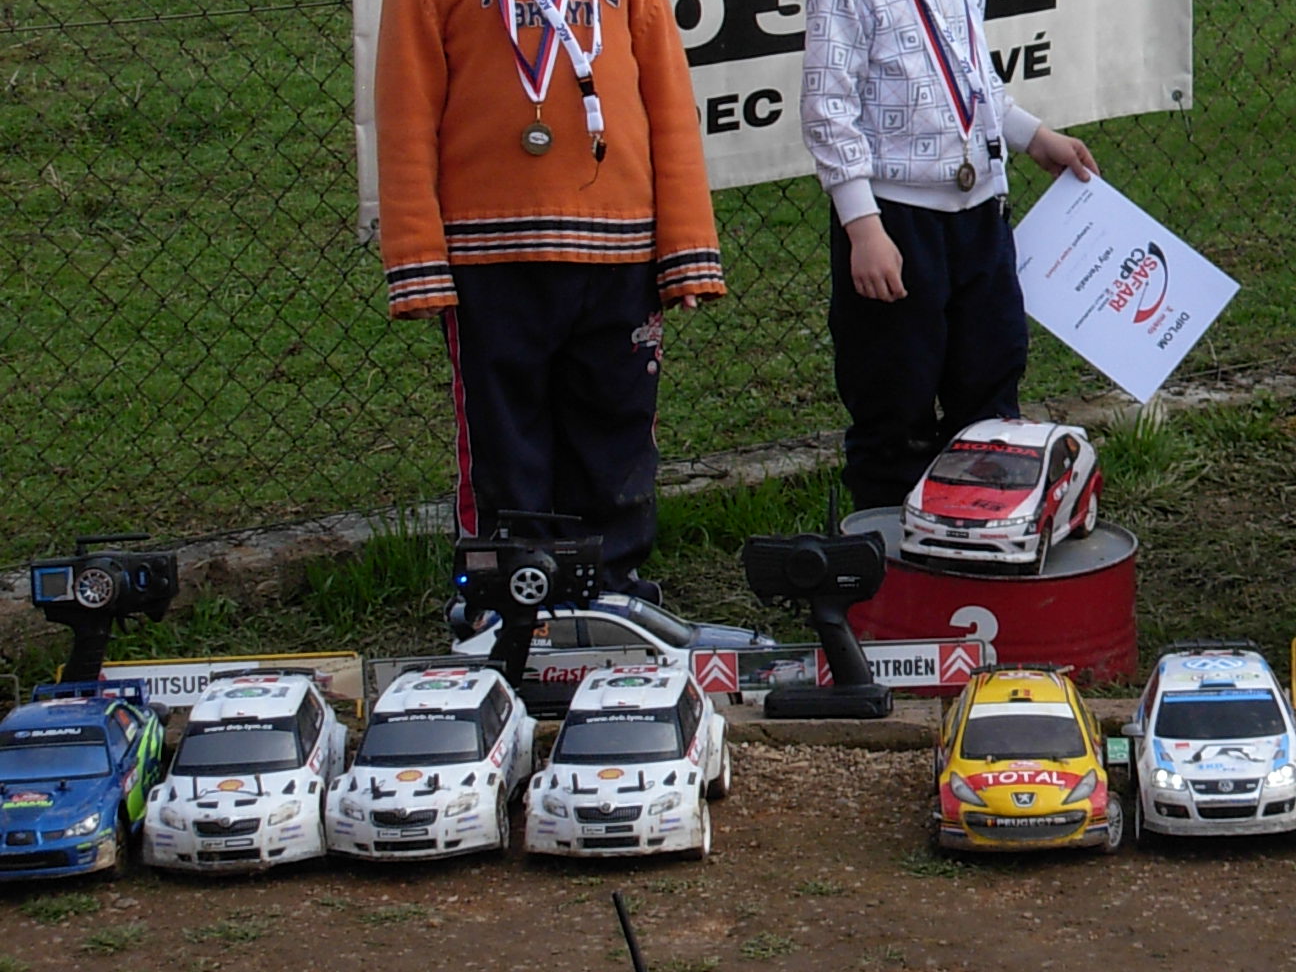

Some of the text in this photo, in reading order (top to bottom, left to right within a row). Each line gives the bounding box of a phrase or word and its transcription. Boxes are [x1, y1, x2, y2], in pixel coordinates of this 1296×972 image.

[556, 23, 571, 42] AGC
[697, 88, 783, 135] EC
[1120, 248, 1146, 280] CUP
[1108, 256, 1158, 313] SAFARI
[1157, 311, 1190, 350] DIPLOM
[951, 442, 1040, 458] HONDA
[31, 728, 82, 737] SUBARU
[981, 771, 1066, 786] TOTAL
